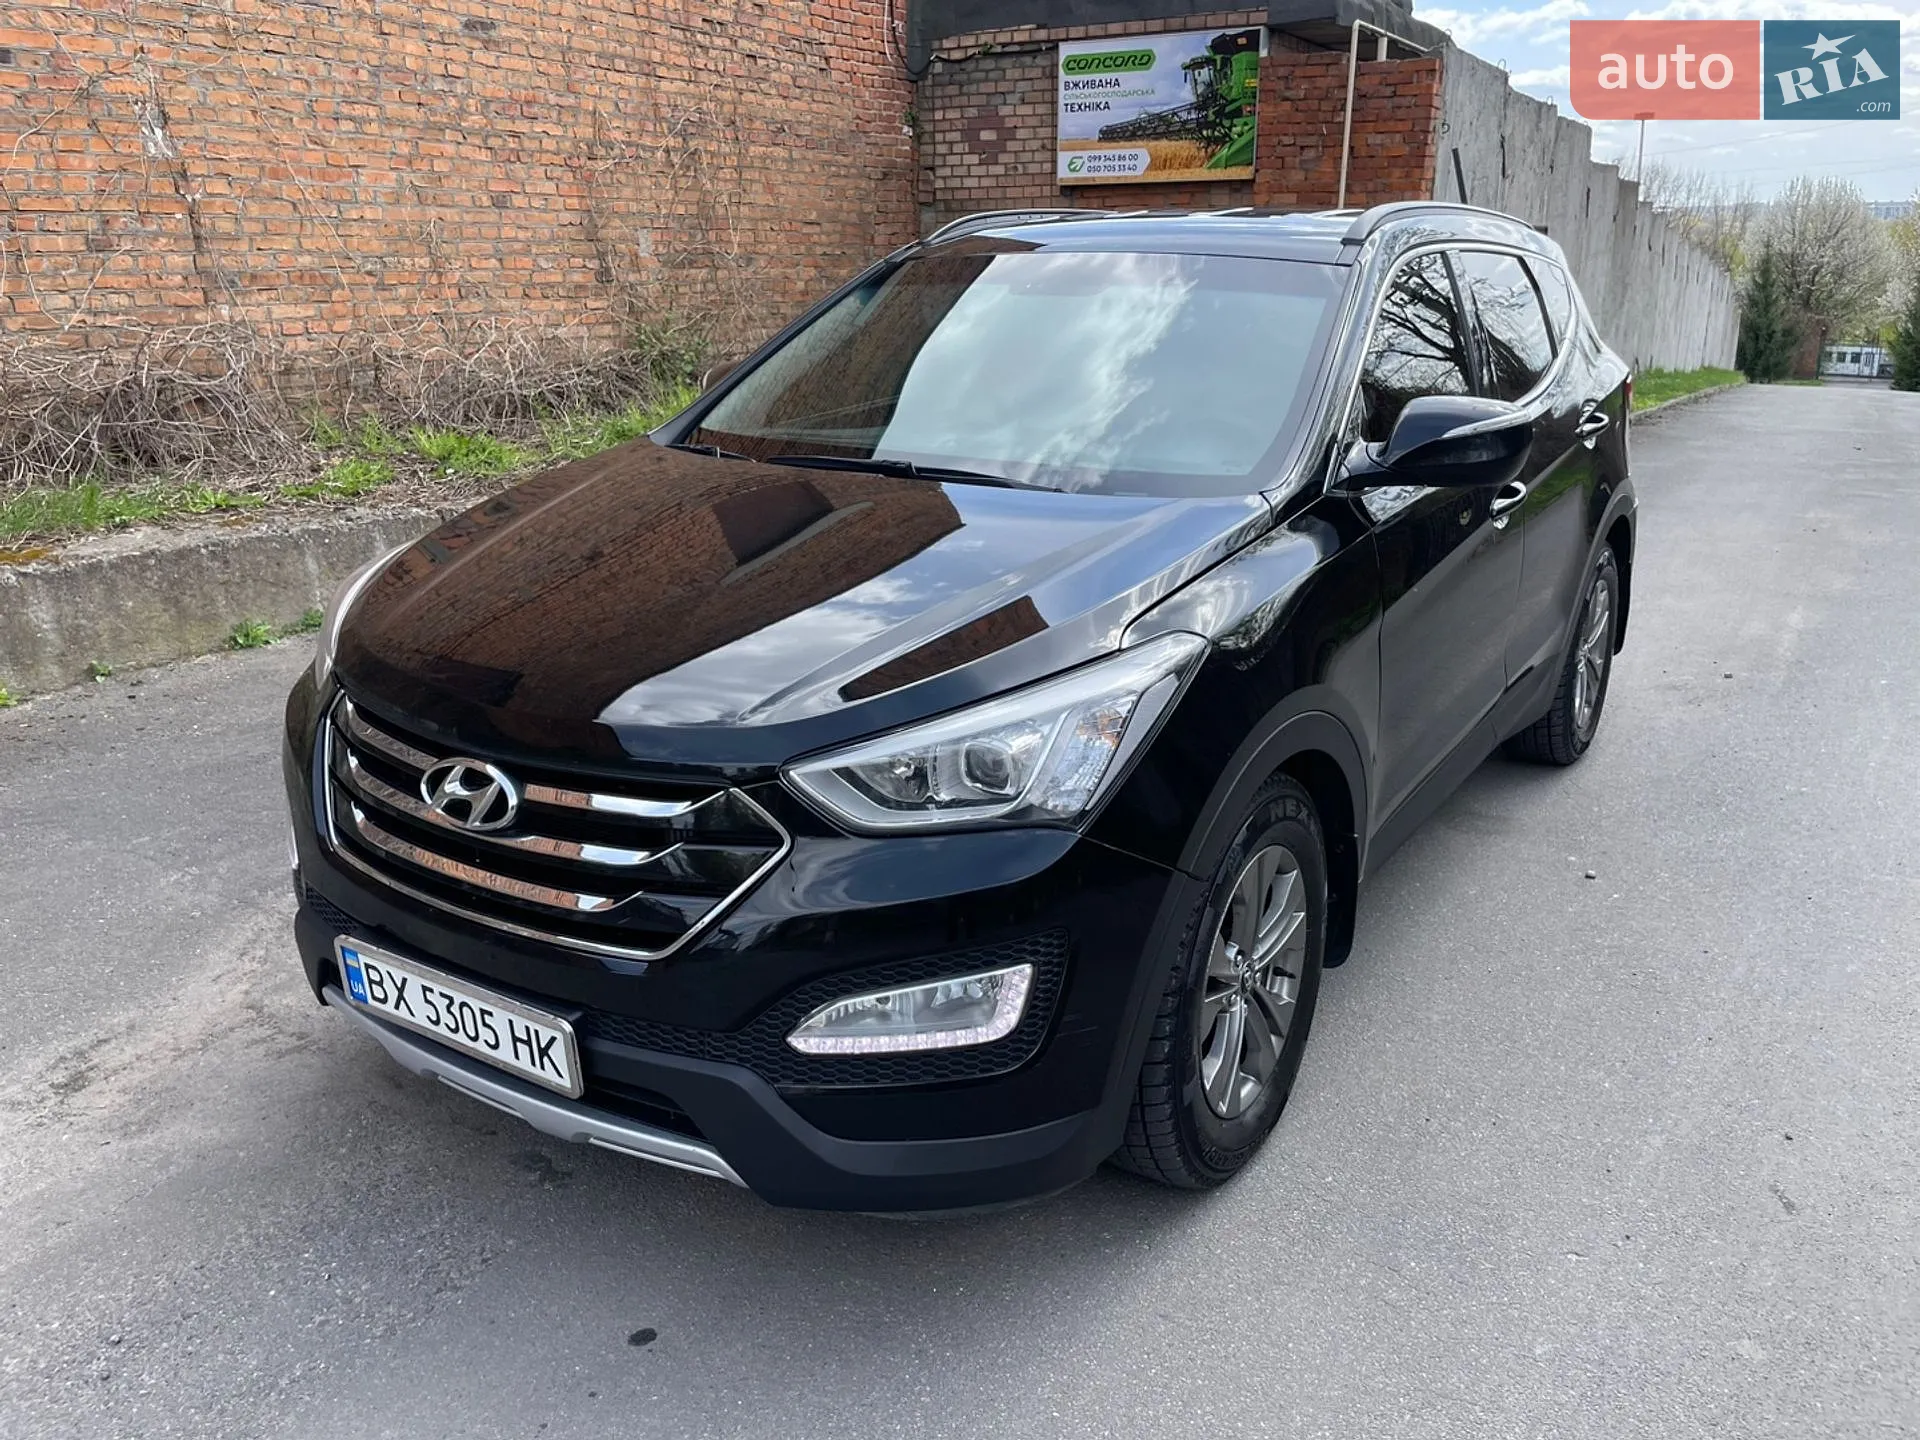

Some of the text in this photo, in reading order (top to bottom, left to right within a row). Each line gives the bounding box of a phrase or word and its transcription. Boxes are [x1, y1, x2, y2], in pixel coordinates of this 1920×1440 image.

[1063, 78, 1121, 91] ВЖИВАНА
[1063, 101, 1111, 113] ТЕХНІКА
[1128, 153, 1139, 161] 00
[1103, 164, 1116, 172] 705
[363, 961, 564, 1079] BX 5305 HK
